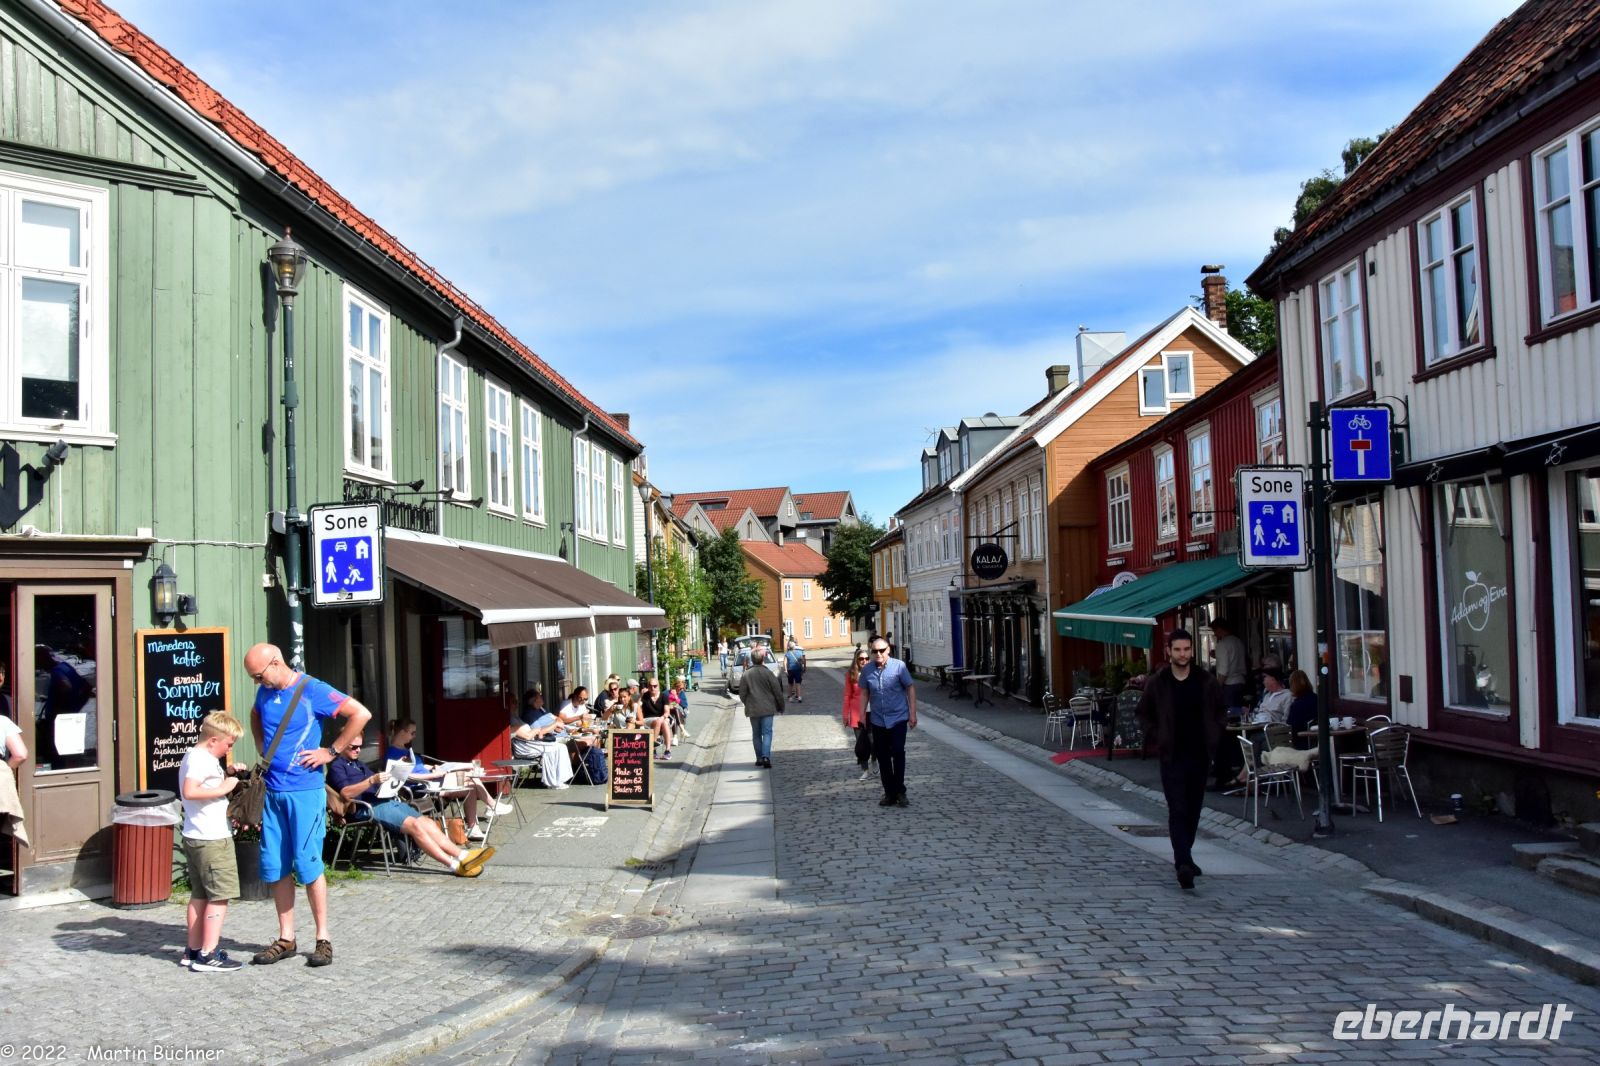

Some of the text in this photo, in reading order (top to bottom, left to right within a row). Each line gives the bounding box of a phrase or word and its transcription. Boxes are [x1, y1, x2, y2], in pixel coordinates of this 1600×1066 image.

[1252, 476, 1293, 493] Sone
[325, 514, 368, 531] Sone
[1451, 586, 1507, 625] Adam og Eva
[148, 639, 196, 653] Månedens
[173, 651, 206, 666] kaffe:
[174, 673, 203, 685] Brasil
[157, 679, 220, 699] Sommer
[166, 700, 203, 720] kaffe
